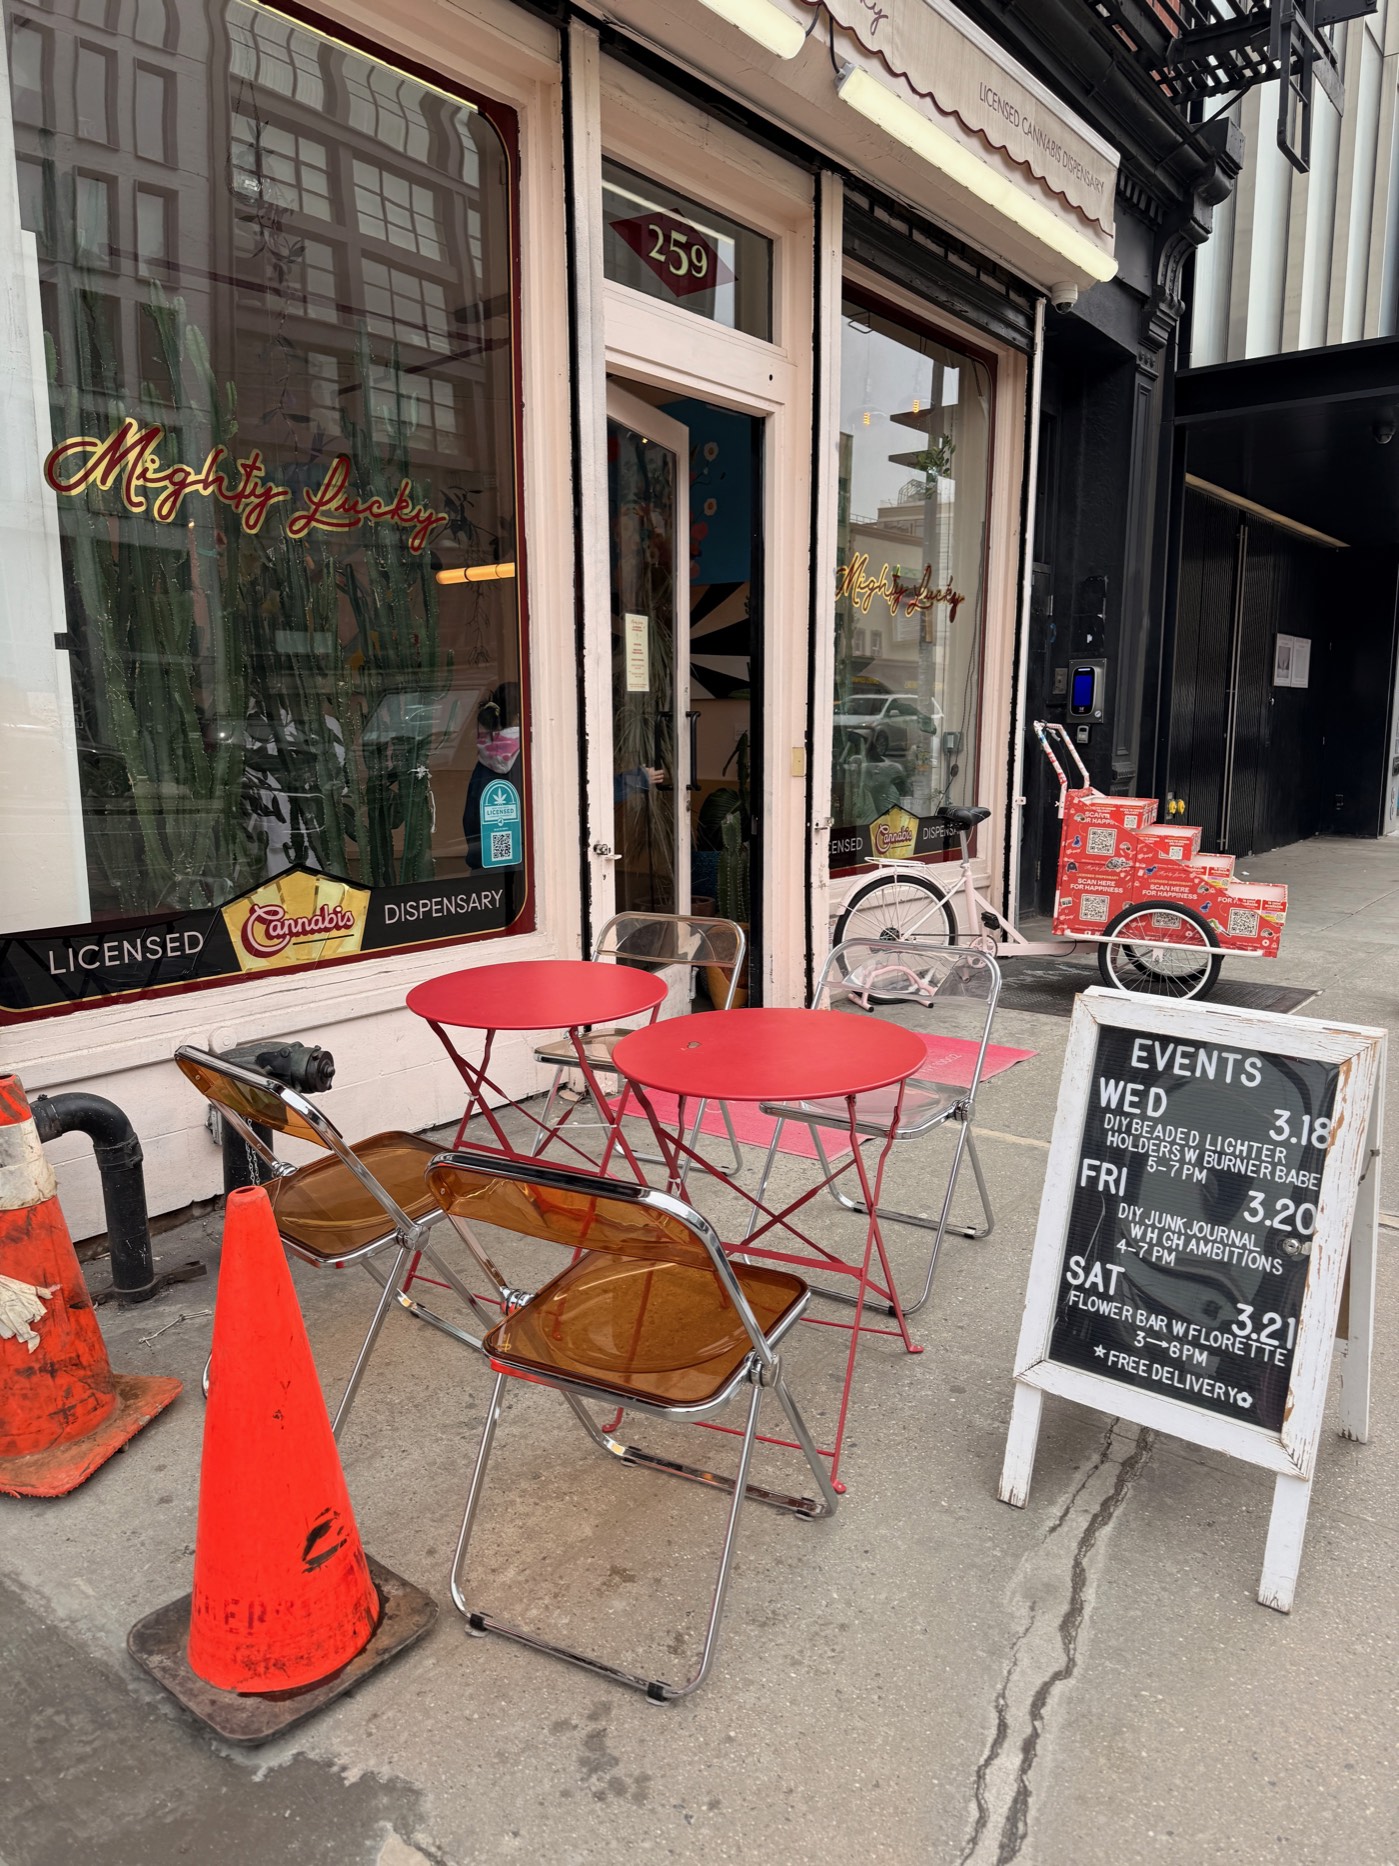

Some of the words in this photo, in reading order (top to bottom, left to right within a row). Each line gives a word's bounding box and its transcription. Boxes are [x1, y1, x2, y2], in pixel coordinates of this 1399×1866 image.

[979, 82, 1020, 127] LICENSED
[1022, 117, 1062, 163] CANNABIS
[1062, 151, 1104, 194] DISPENSARY
[648, 224, 708, 278] 259
[44, 417, 291, 534] Mighty
[287, 452, 449, 555] Lucky
[835, 552, 908, 616] Mighty
[905, 563, 965, 623] Lucky
[486, 808, 514, 816] LICENSED
[875, 824, 912, 855] Cannabis
[1084, 885, 1124, 893] HAPPINESS
[1150, 884, 1171, 892] SCAN
[1157, 891, 1198, 900] HAPPINESS
[1217, 896, 1232, 904] FOR
[49, 930, 204, 974] LICENSED
[241, 904, 356, 958] Cannabis
[384, 890, 504, 924] DISPENSARY
[1131, 1038, 1262, 1087] EVENTS
[1100, 1077, 1168, 1118] WED
[1104, 1113, 1130, 1133] DIY
[1131, 1119, 1199, 1146] BEADED
[1205, 1133, 1287, 1164] LIGHTER
[1268, 1108, 1331, 1149] 3.18
[1080, 1158, 1127, 1197] FRI
[1107, 1131, 1181, 1158] HOLDERS
[1184, 1148, 1199, 1165] W
[1203, 1151, 1271, 1180] BURNER
[1274, 1167, 1321, 1191] BABE
[1118, 1203, 1144, 1222] DIY
[1145, 1210, 1188, 1234] JUNK
[1187, 1222, 1261, 1252] JOURNAL
[1243, 1190, 1317, 1235] 3.20
[1130, 1222, 1145, 1240] W
[1186, 1238, 1283, 1275] AMBITIONS
[1151, 1248, 1176, 1267] PM
[1066, 1255, 1126, 1296] SAT
[1068, 1290, 1133, 1322] FLOWER
[1136, 1309, 1168, 1333] BAR
[1172, 1319, 1188, 1338] W
[1188, 1324, 1288, 1367] FLORETTE
[1231, 1302, 1297, 1350] 3.21
[1108, 1350, 1150, 1377] FREE
[1151, 1363, 1237, 1404] DELIVERY
